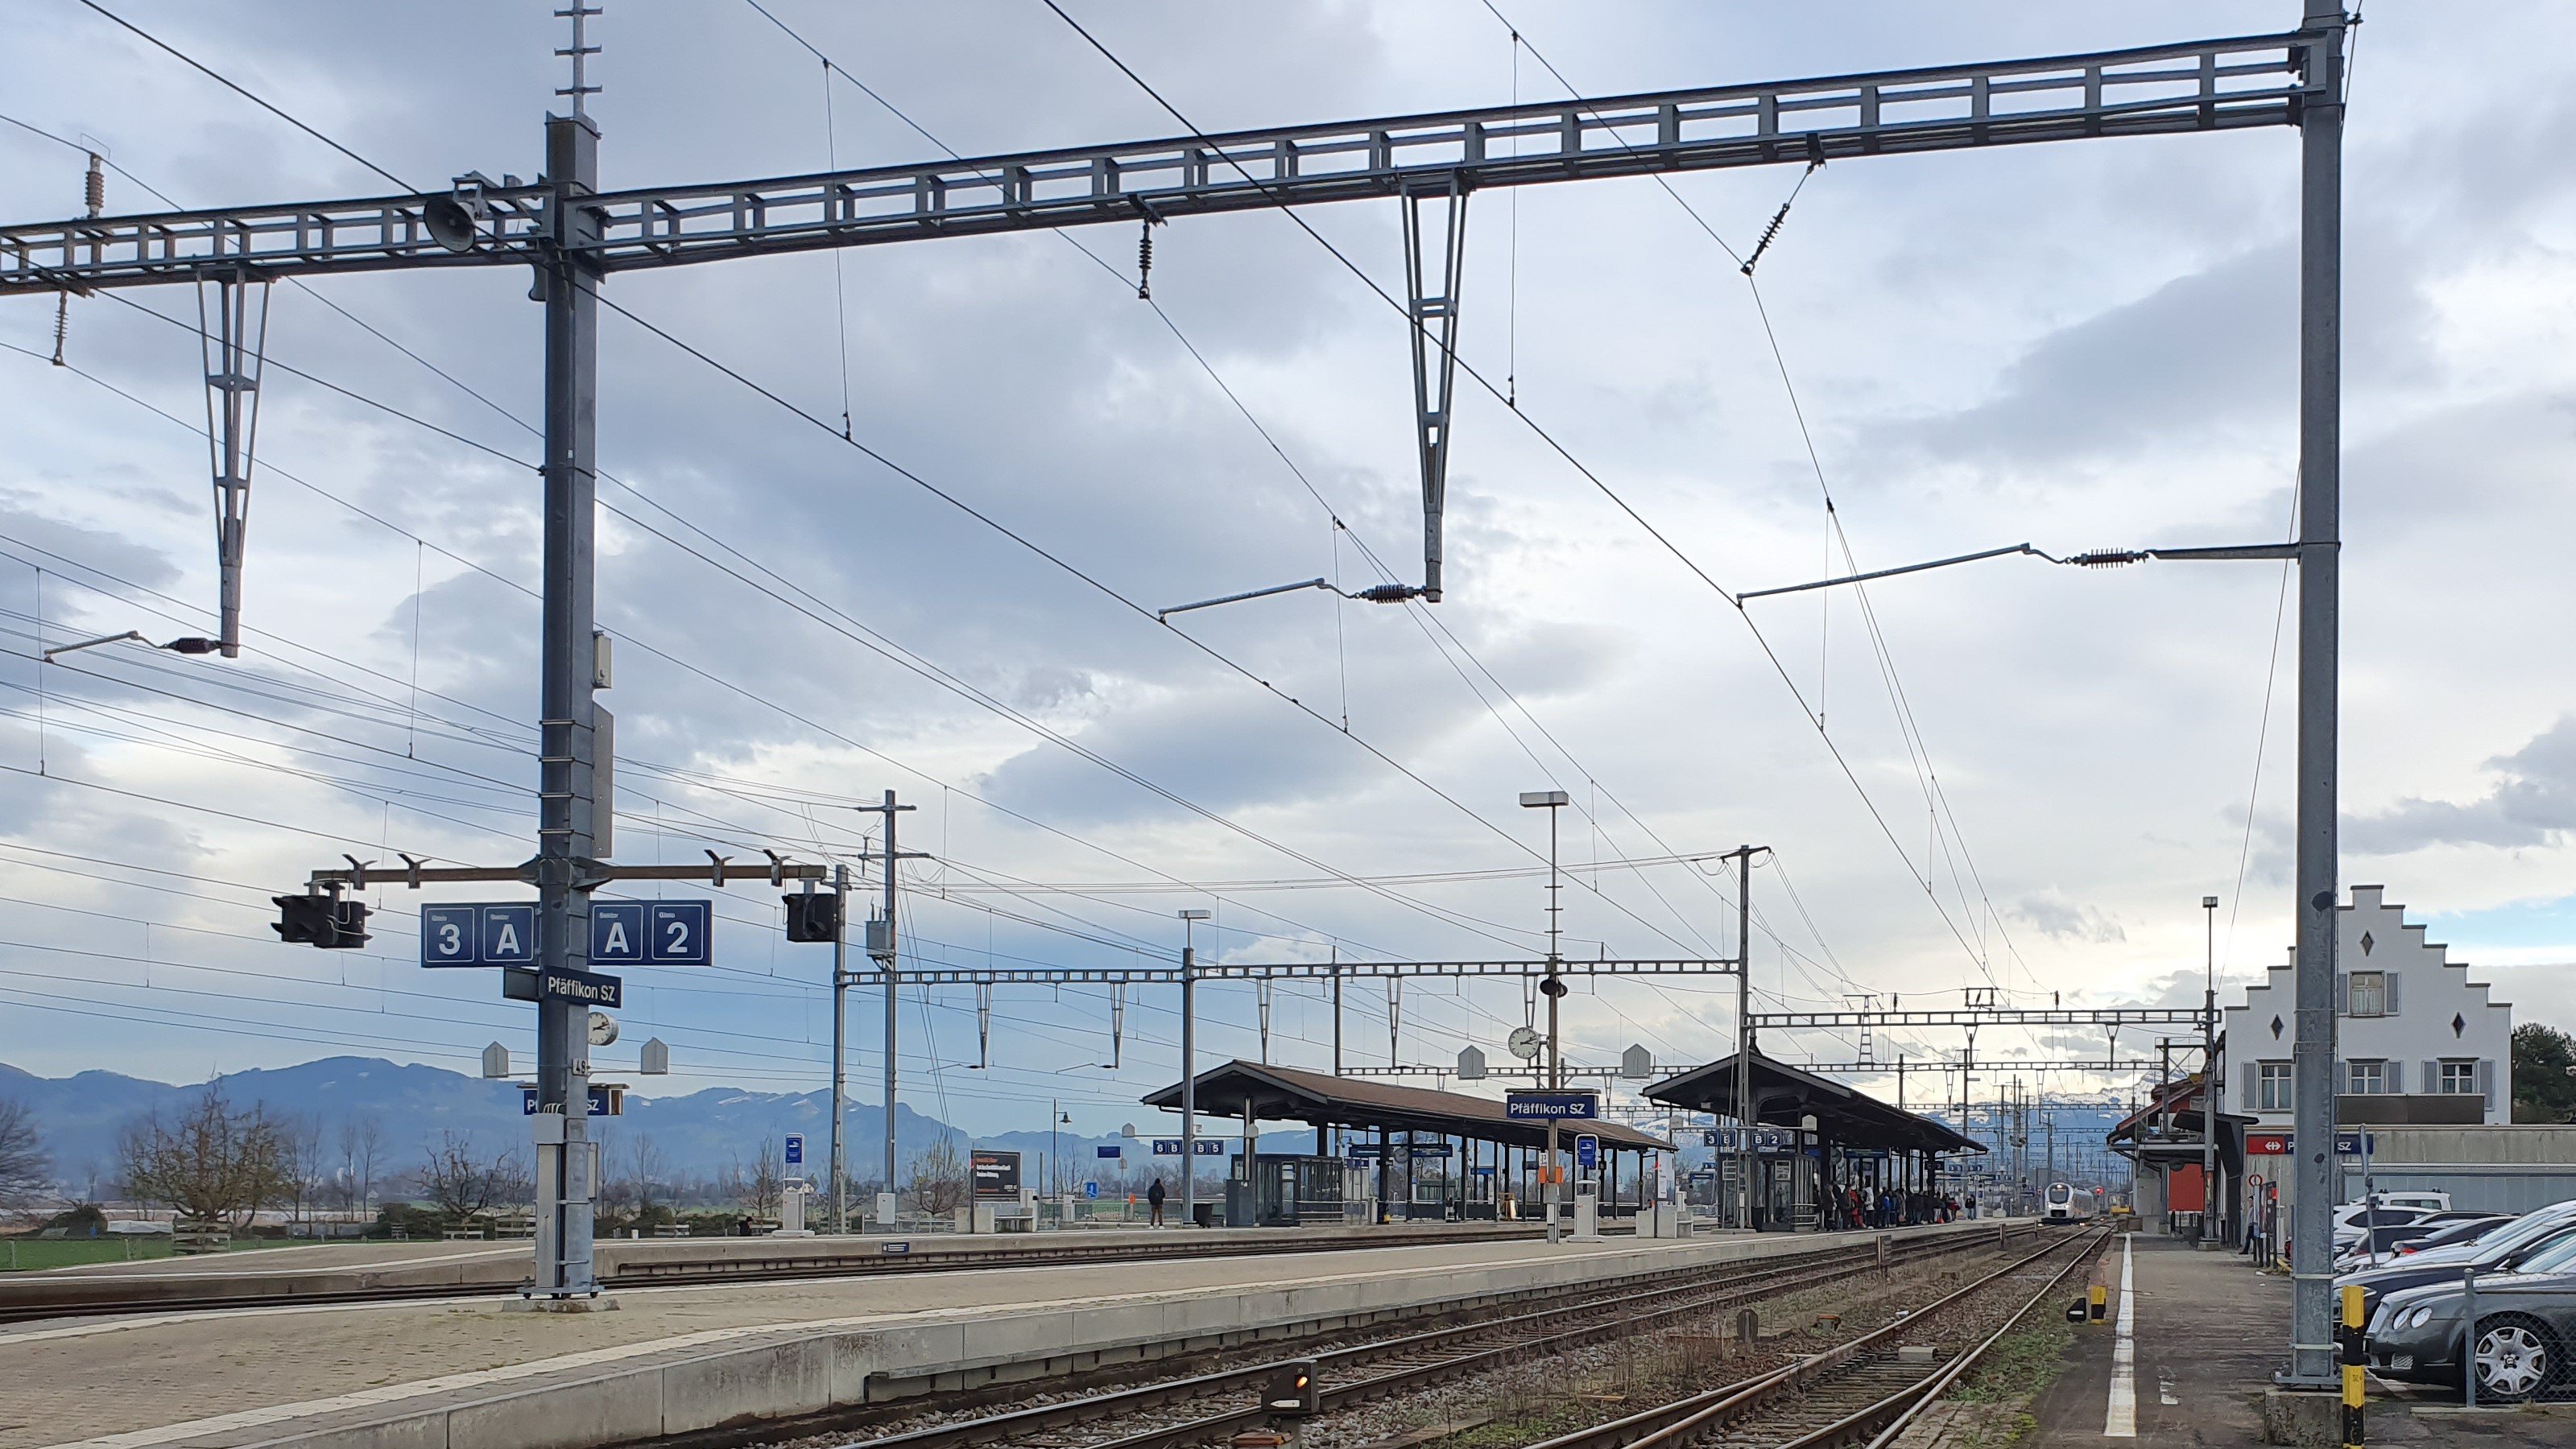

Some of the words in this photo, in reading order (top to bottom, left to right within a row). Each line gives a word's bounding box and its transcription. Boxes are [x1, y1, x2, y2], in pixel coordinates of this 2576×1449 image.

[438, 923, 461, 956] 3
[496, 923, 521, 955] A
[604, 922, 630, 953] A
[666, 921, 688, 953] 2
[548, 976, 598, 1000] Pfäffikon
[601, 985, 616, 1002] SZ
[1510, 1103, 1566, 1114] Pfäffikon
[1569, 1103, 1586, 1115] SZ
[1708, 1135, 1715, 1145] 3
[1755, 1135, 1763, 1144] B
[1771, 1135, 1778, 1144] 2
[1156, 1144, 1164, 1154] 6
[1197, 1144, 1205, 1153] B
[1212, 1144, 1219, 1153] 5
[2337, 1141, 2351, 1151] SZ
